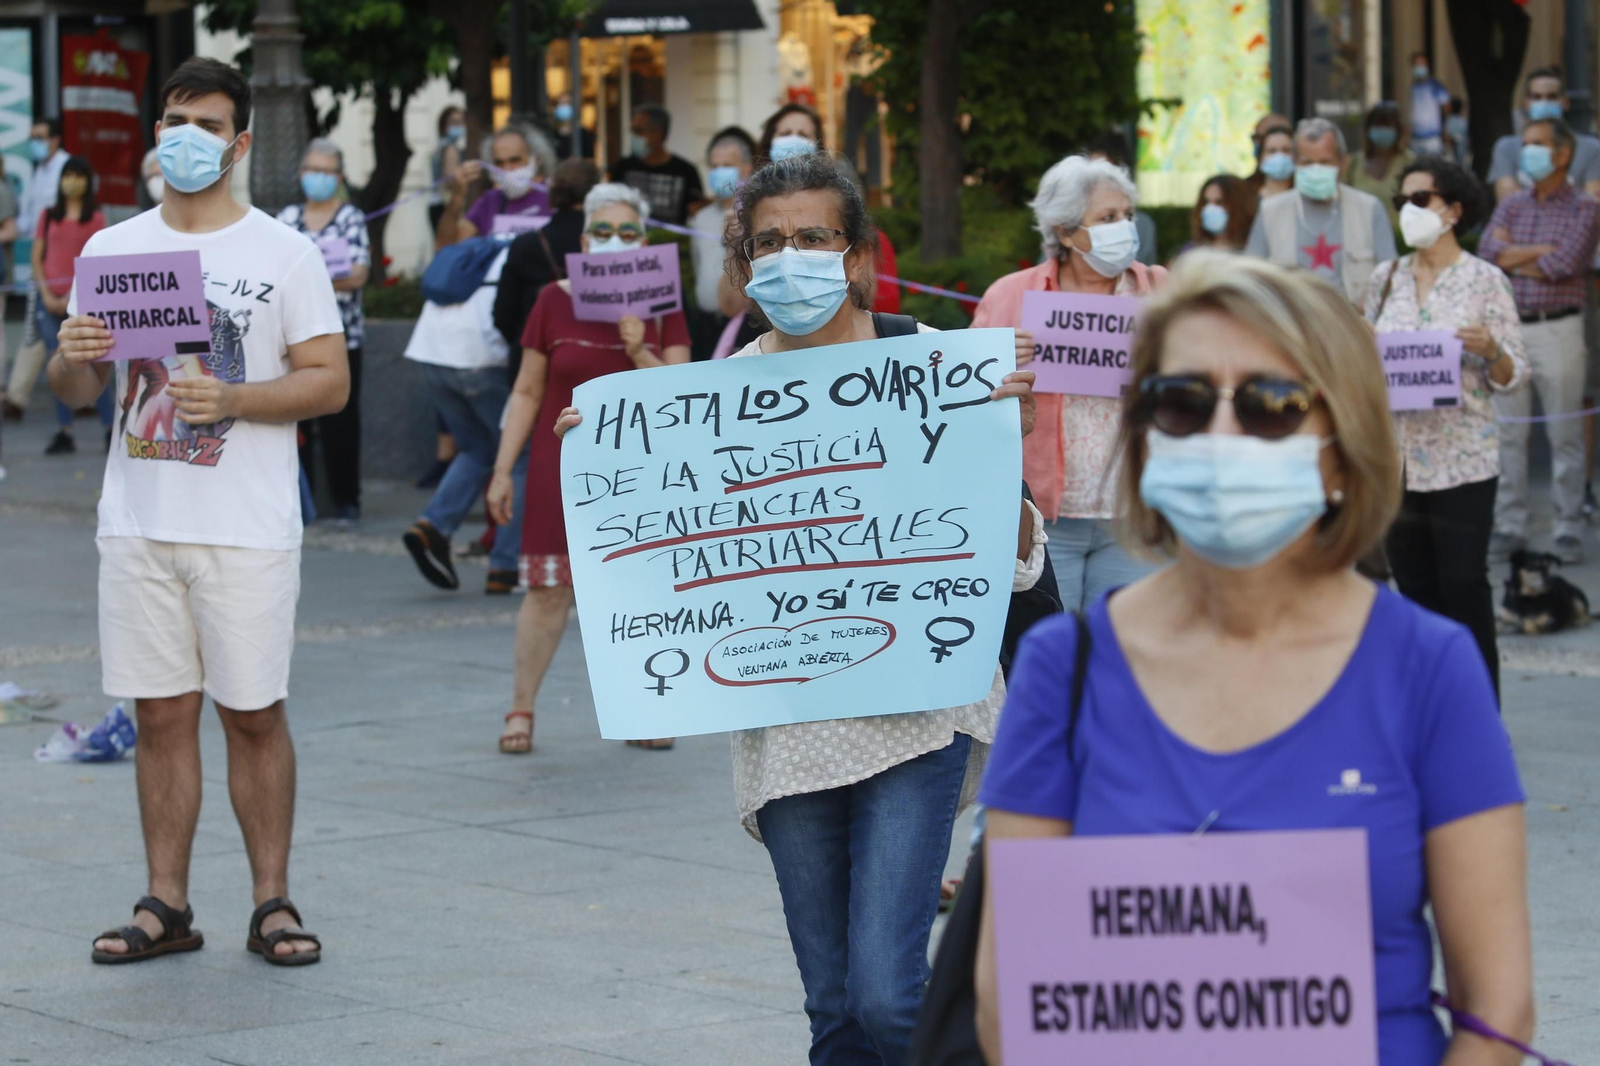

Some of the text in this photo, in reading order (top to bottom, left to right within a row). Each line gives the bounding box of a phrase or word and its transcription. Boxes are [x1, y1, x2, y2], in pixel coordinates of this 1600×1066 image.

[95, 271, 180, 295] JUSTICIA
[87, 306, 201, 330] ATRIARCAL
[1045, 310, 1136, 334] JUSTICIA
[1032, 343, 1129, 369] PATRIARC
[1383, 344, 1443, 361] JUSTICIA
[595, 393, 721, 454] HASTA
[737, 380, 809, 424] LOS
[574, 467, 643, 506] DE
[662, 462, 699, 492] LA
[920, 423, 947, 464] Y
[589, 485, 862, 551] SENTENCIAS
[647, 507, 969, 578] PATRIARCALES
[611, 601, 745, 643] HERMANA.
[767, 590, 809, 623] YO
[862, 580, 901, 606] TE
[912, 577, 990, 606] CREO
[800, 633, 820, 645] DE
[831, 626, 888, 639] MUJERES
[738, 652, 853, 678] VENTANA ABIERTA
[1090, 883, 1268, 945] HERMANA,
[1030, 975, 1352, 1033] ESTAMOS CONTIGO
